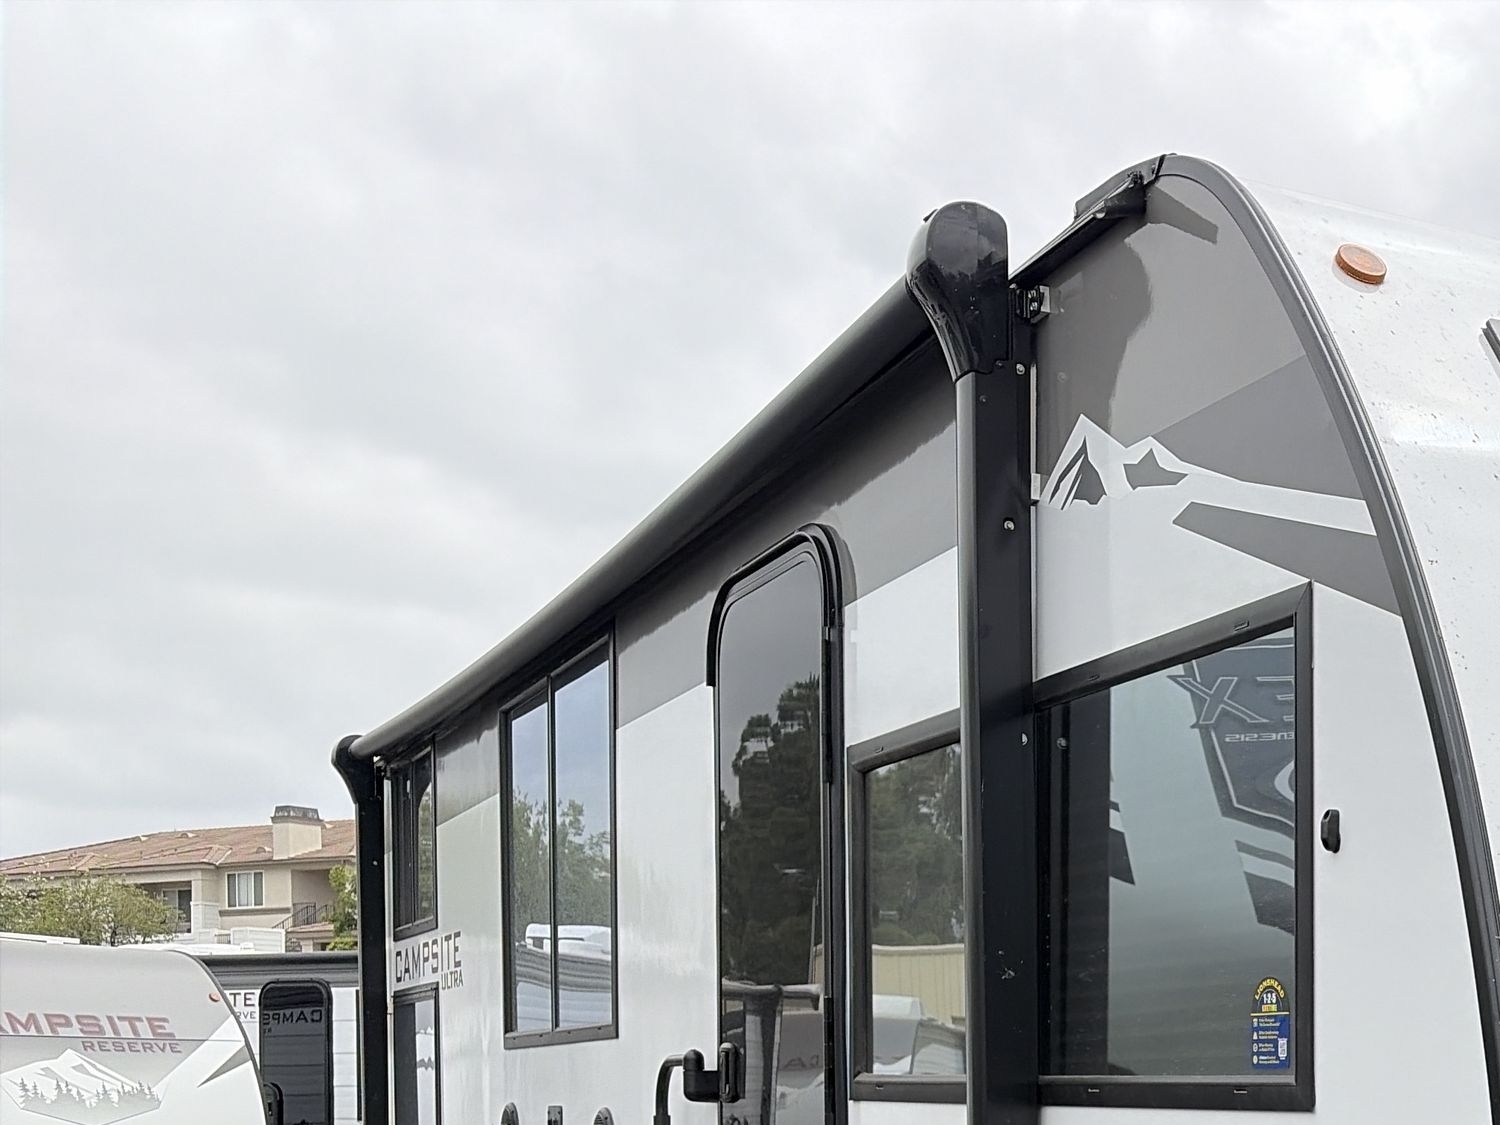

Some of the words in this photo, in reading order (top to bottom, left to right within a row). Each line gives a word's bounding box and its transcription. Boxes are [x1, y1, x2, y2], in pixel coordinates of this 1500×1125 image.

[396, 930, 462, 983] CAMPSITE
[441, 969, 464, 991] ULTRA
[0, 1012, 176, 1040] MPSITE
[81, 1040, 183, 1054] RESERVE
